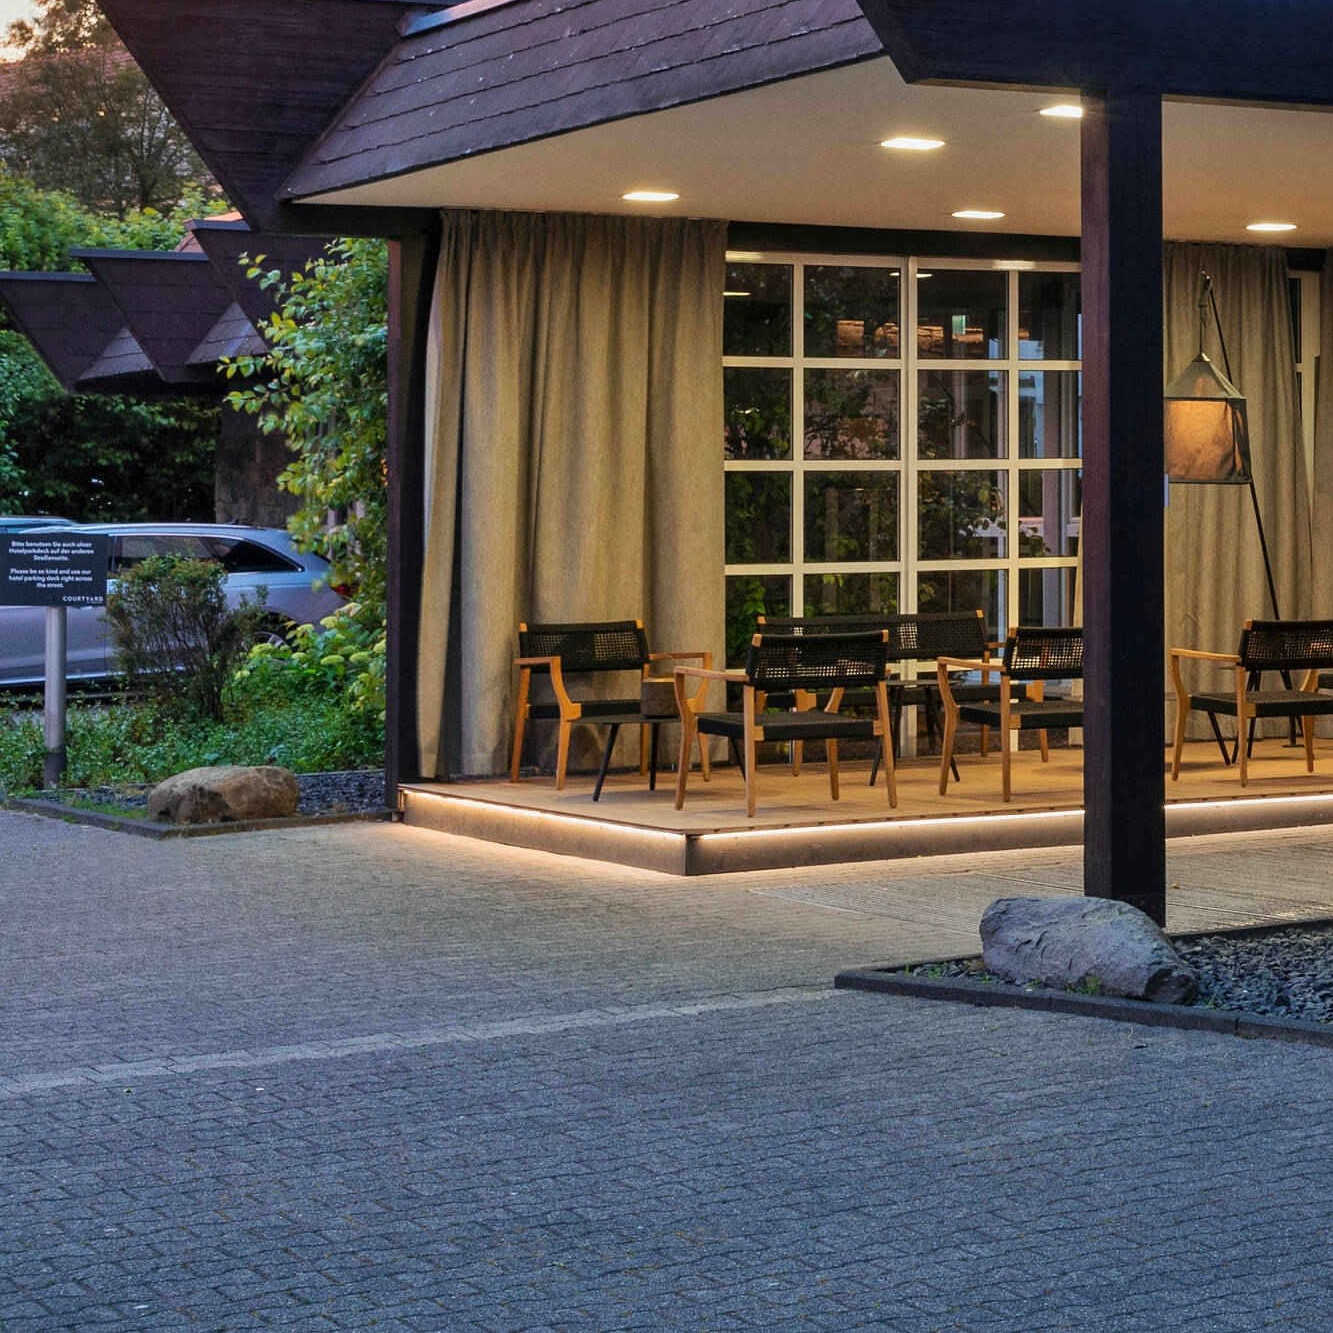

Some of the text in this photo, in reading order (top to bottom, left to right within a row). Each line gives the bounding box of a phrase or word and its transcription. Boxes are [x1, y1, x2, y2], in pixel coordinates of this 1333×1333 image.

[8, 575, 93, 583] hotel parking deck right across
[62, 595, 104, 603] COURTYARD
